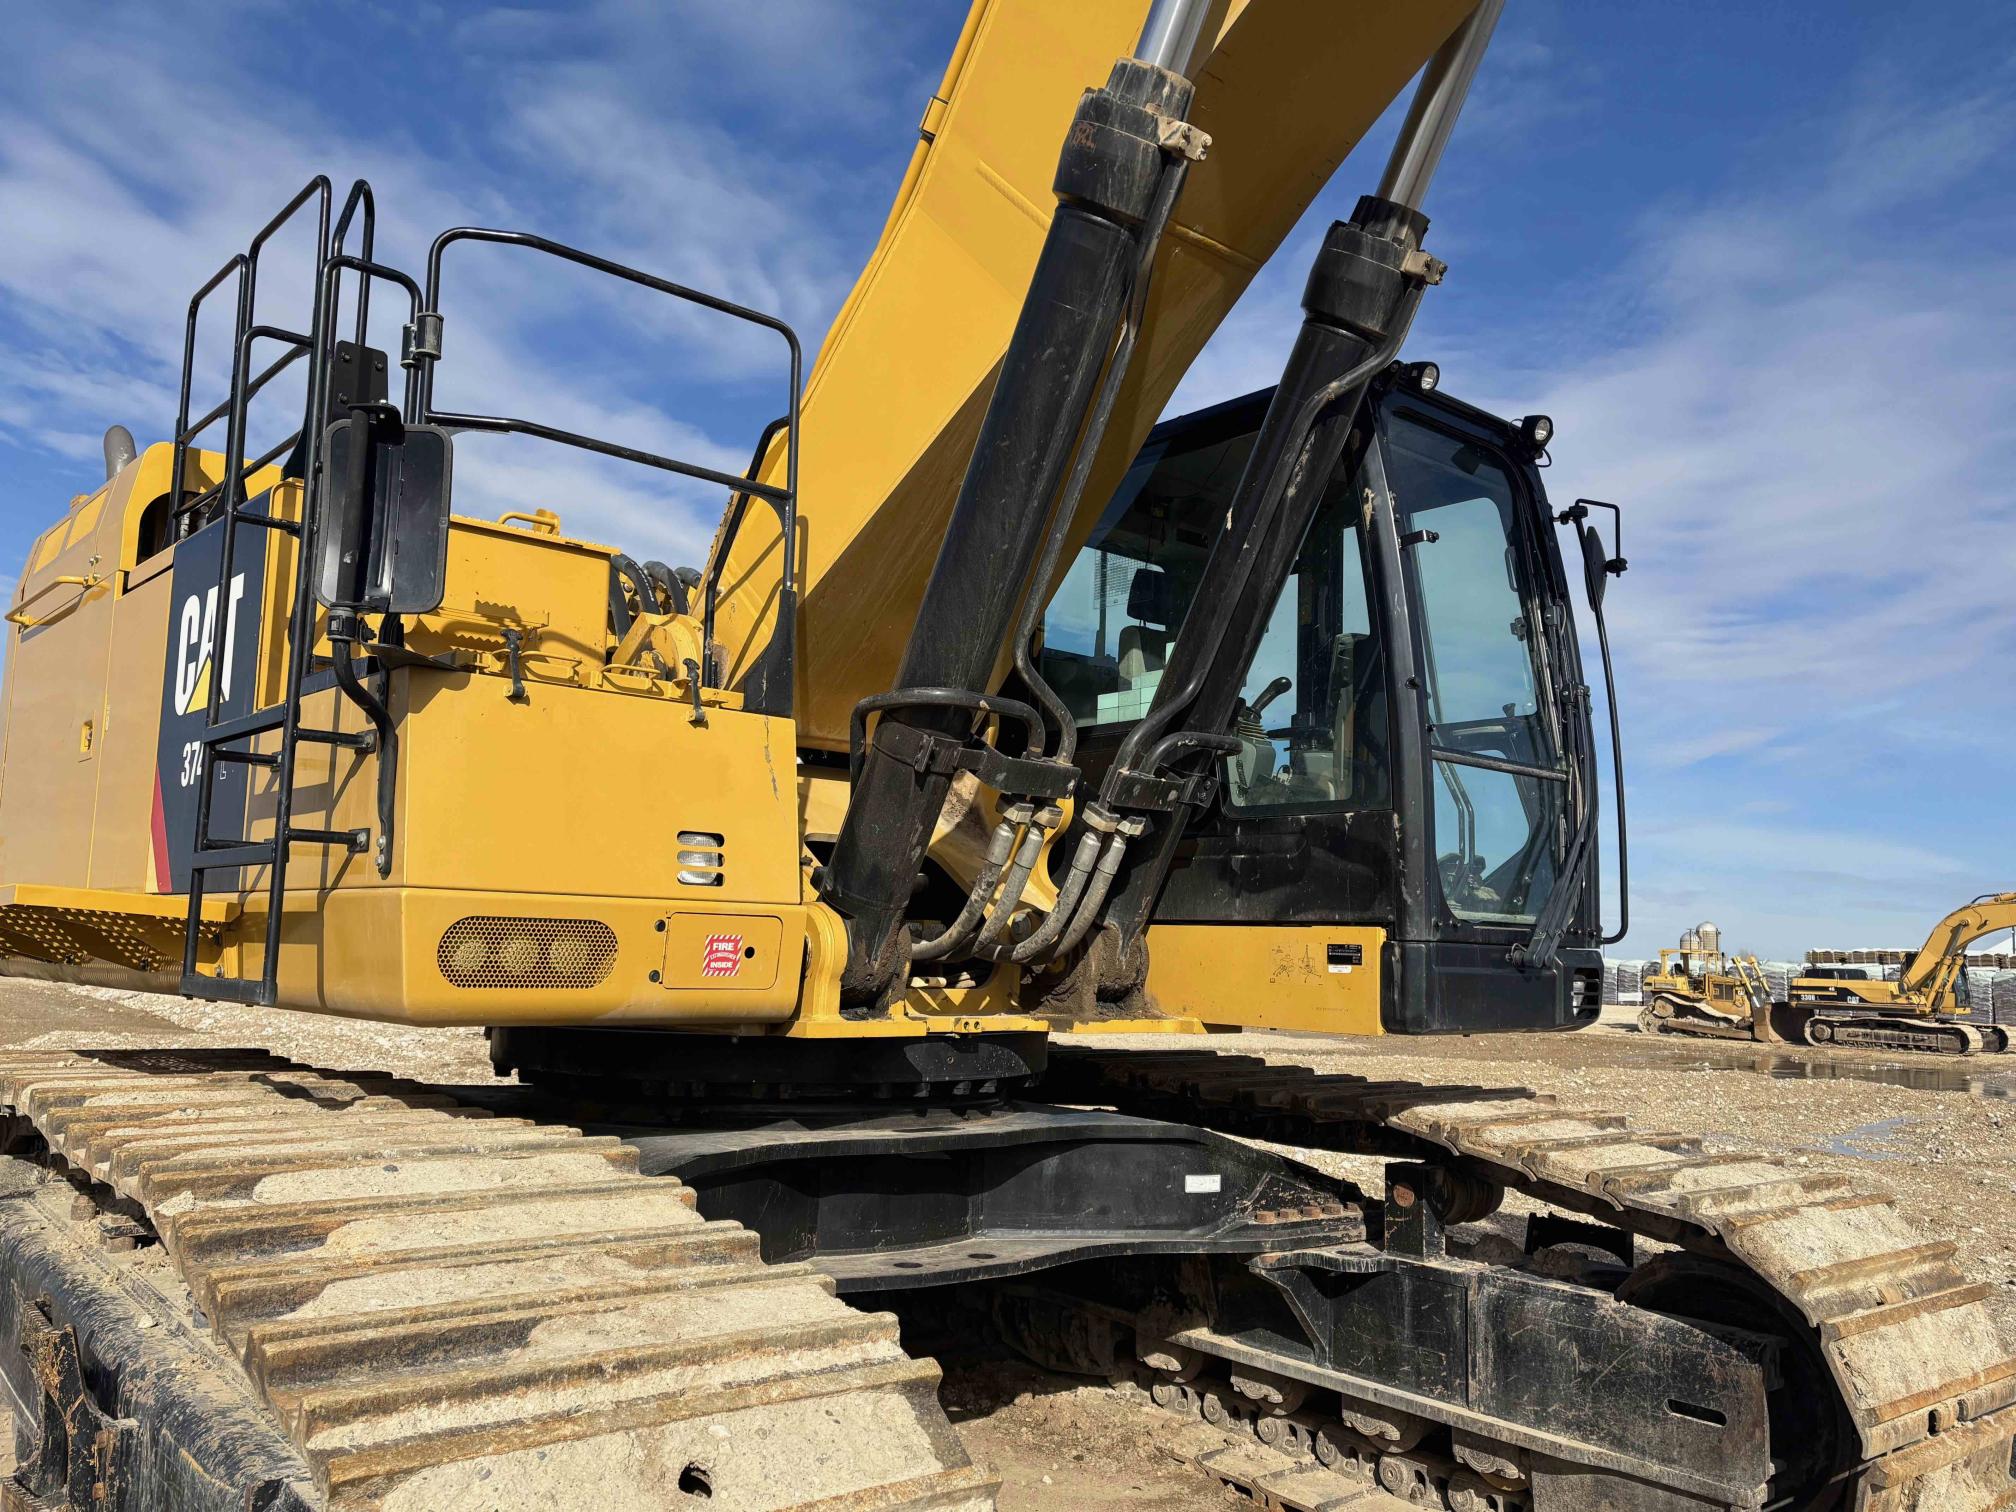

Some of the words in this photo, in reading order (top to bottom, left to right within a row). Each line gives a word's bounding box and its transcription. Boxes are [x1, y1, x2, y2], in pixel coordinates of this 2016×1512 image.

[174, 573, 245, 716] CAT
[713, 942, 735, 951] FIRE
[1846, 995, 1860, 1004] CAT
